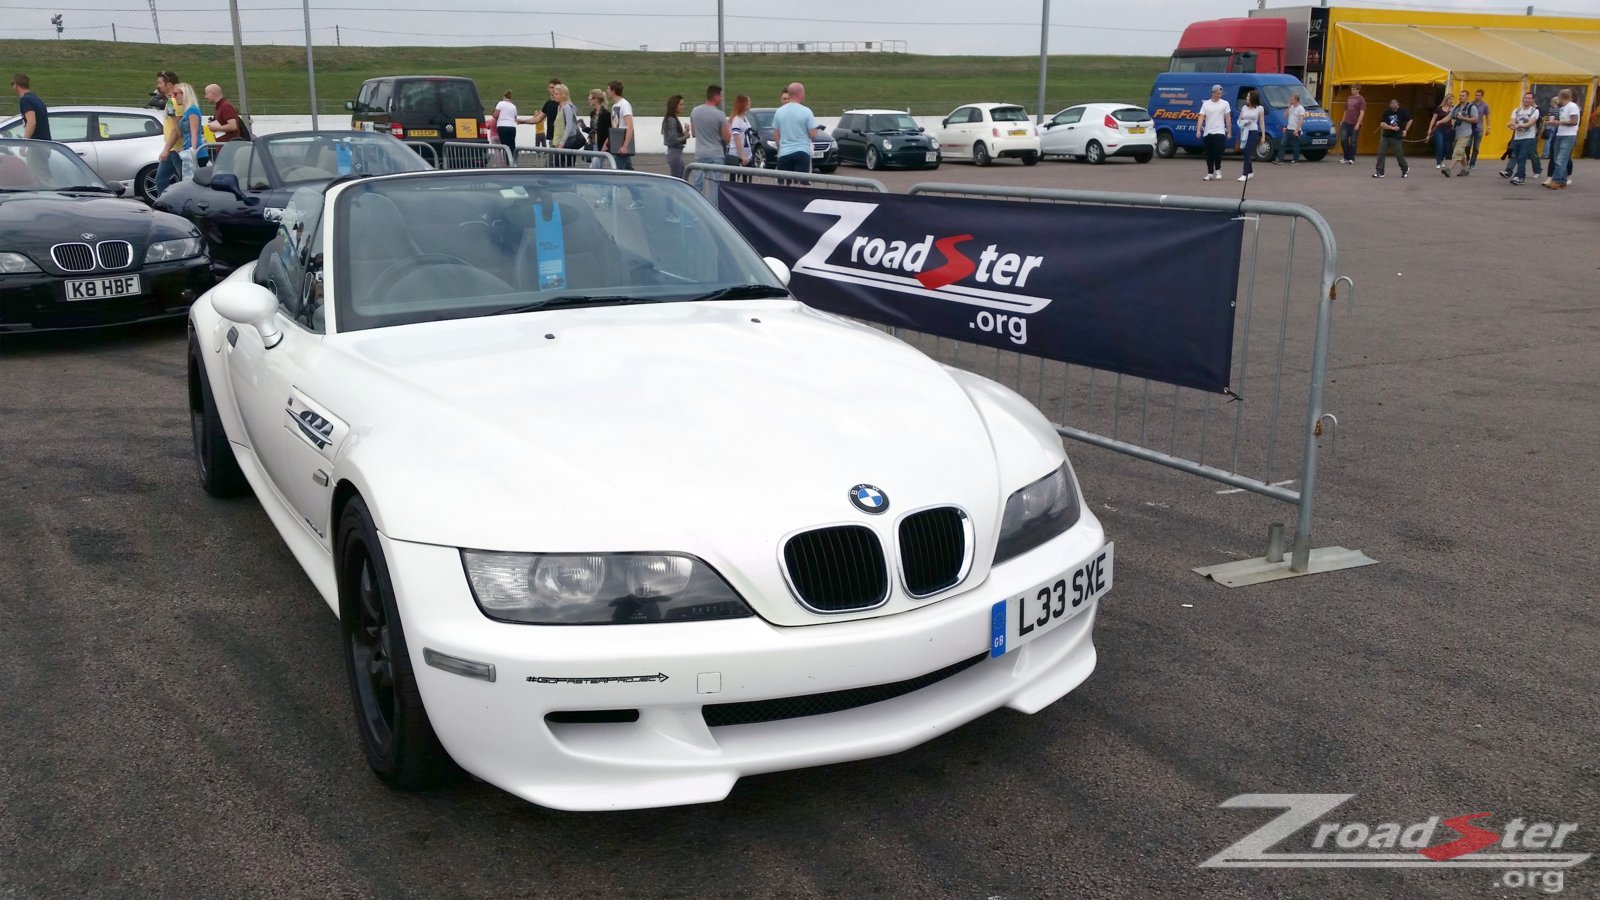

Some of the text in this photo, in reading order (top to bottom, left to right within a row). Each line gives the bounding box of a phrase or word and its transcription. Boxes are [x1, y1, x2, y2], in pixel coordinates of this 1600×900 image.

[73, 278, 134, 298] K8 HBF
[969, 311, 1027, 345] .org
[1019, 552, 1106, 637] L33 SXE
[994, 635, 1004, 648] GB
